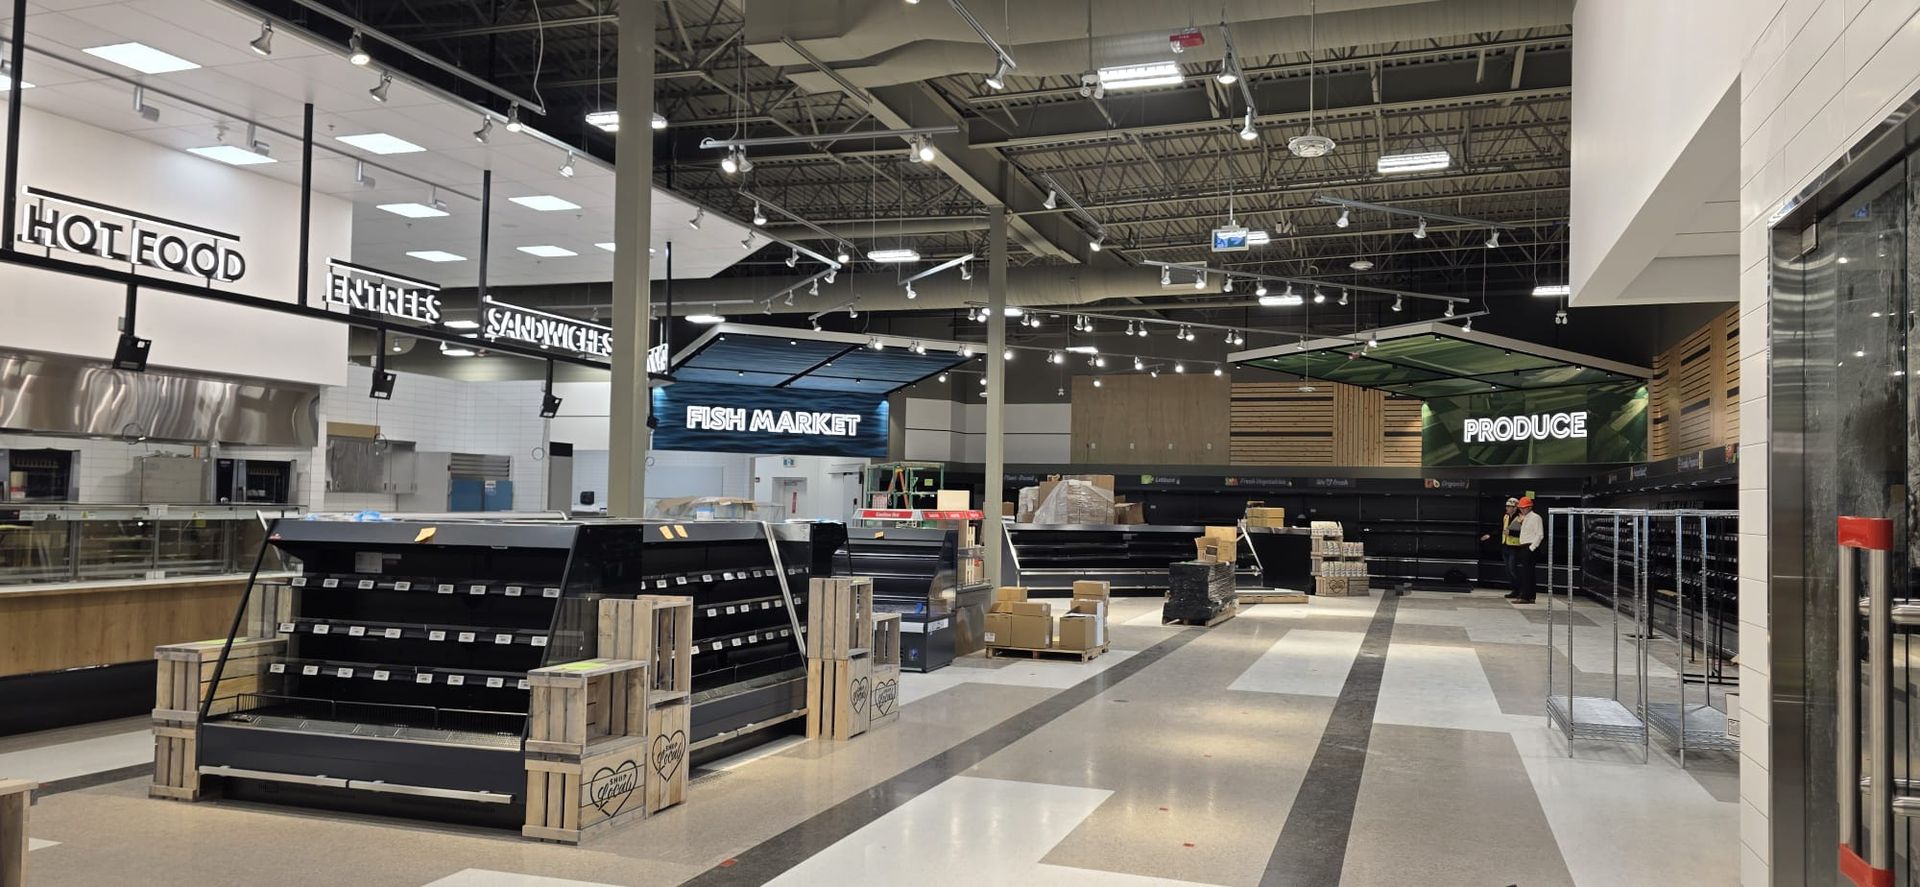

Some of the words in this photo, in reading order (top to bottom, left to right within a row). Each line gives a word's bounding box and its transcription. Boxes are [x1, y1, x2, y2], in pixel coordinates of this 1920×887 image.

[22, 203, 123, 259] HOT
[131, 227, 246, 283] FOOD
[325, 271, 442, 325] ENTREES
[485, 306, 613, 357] SANDWICHES
[686, 405, 746, 431] FISH
[749, 409, 861, 436] MARKET
[1463, 412, 1588, 443] PRODUCE
